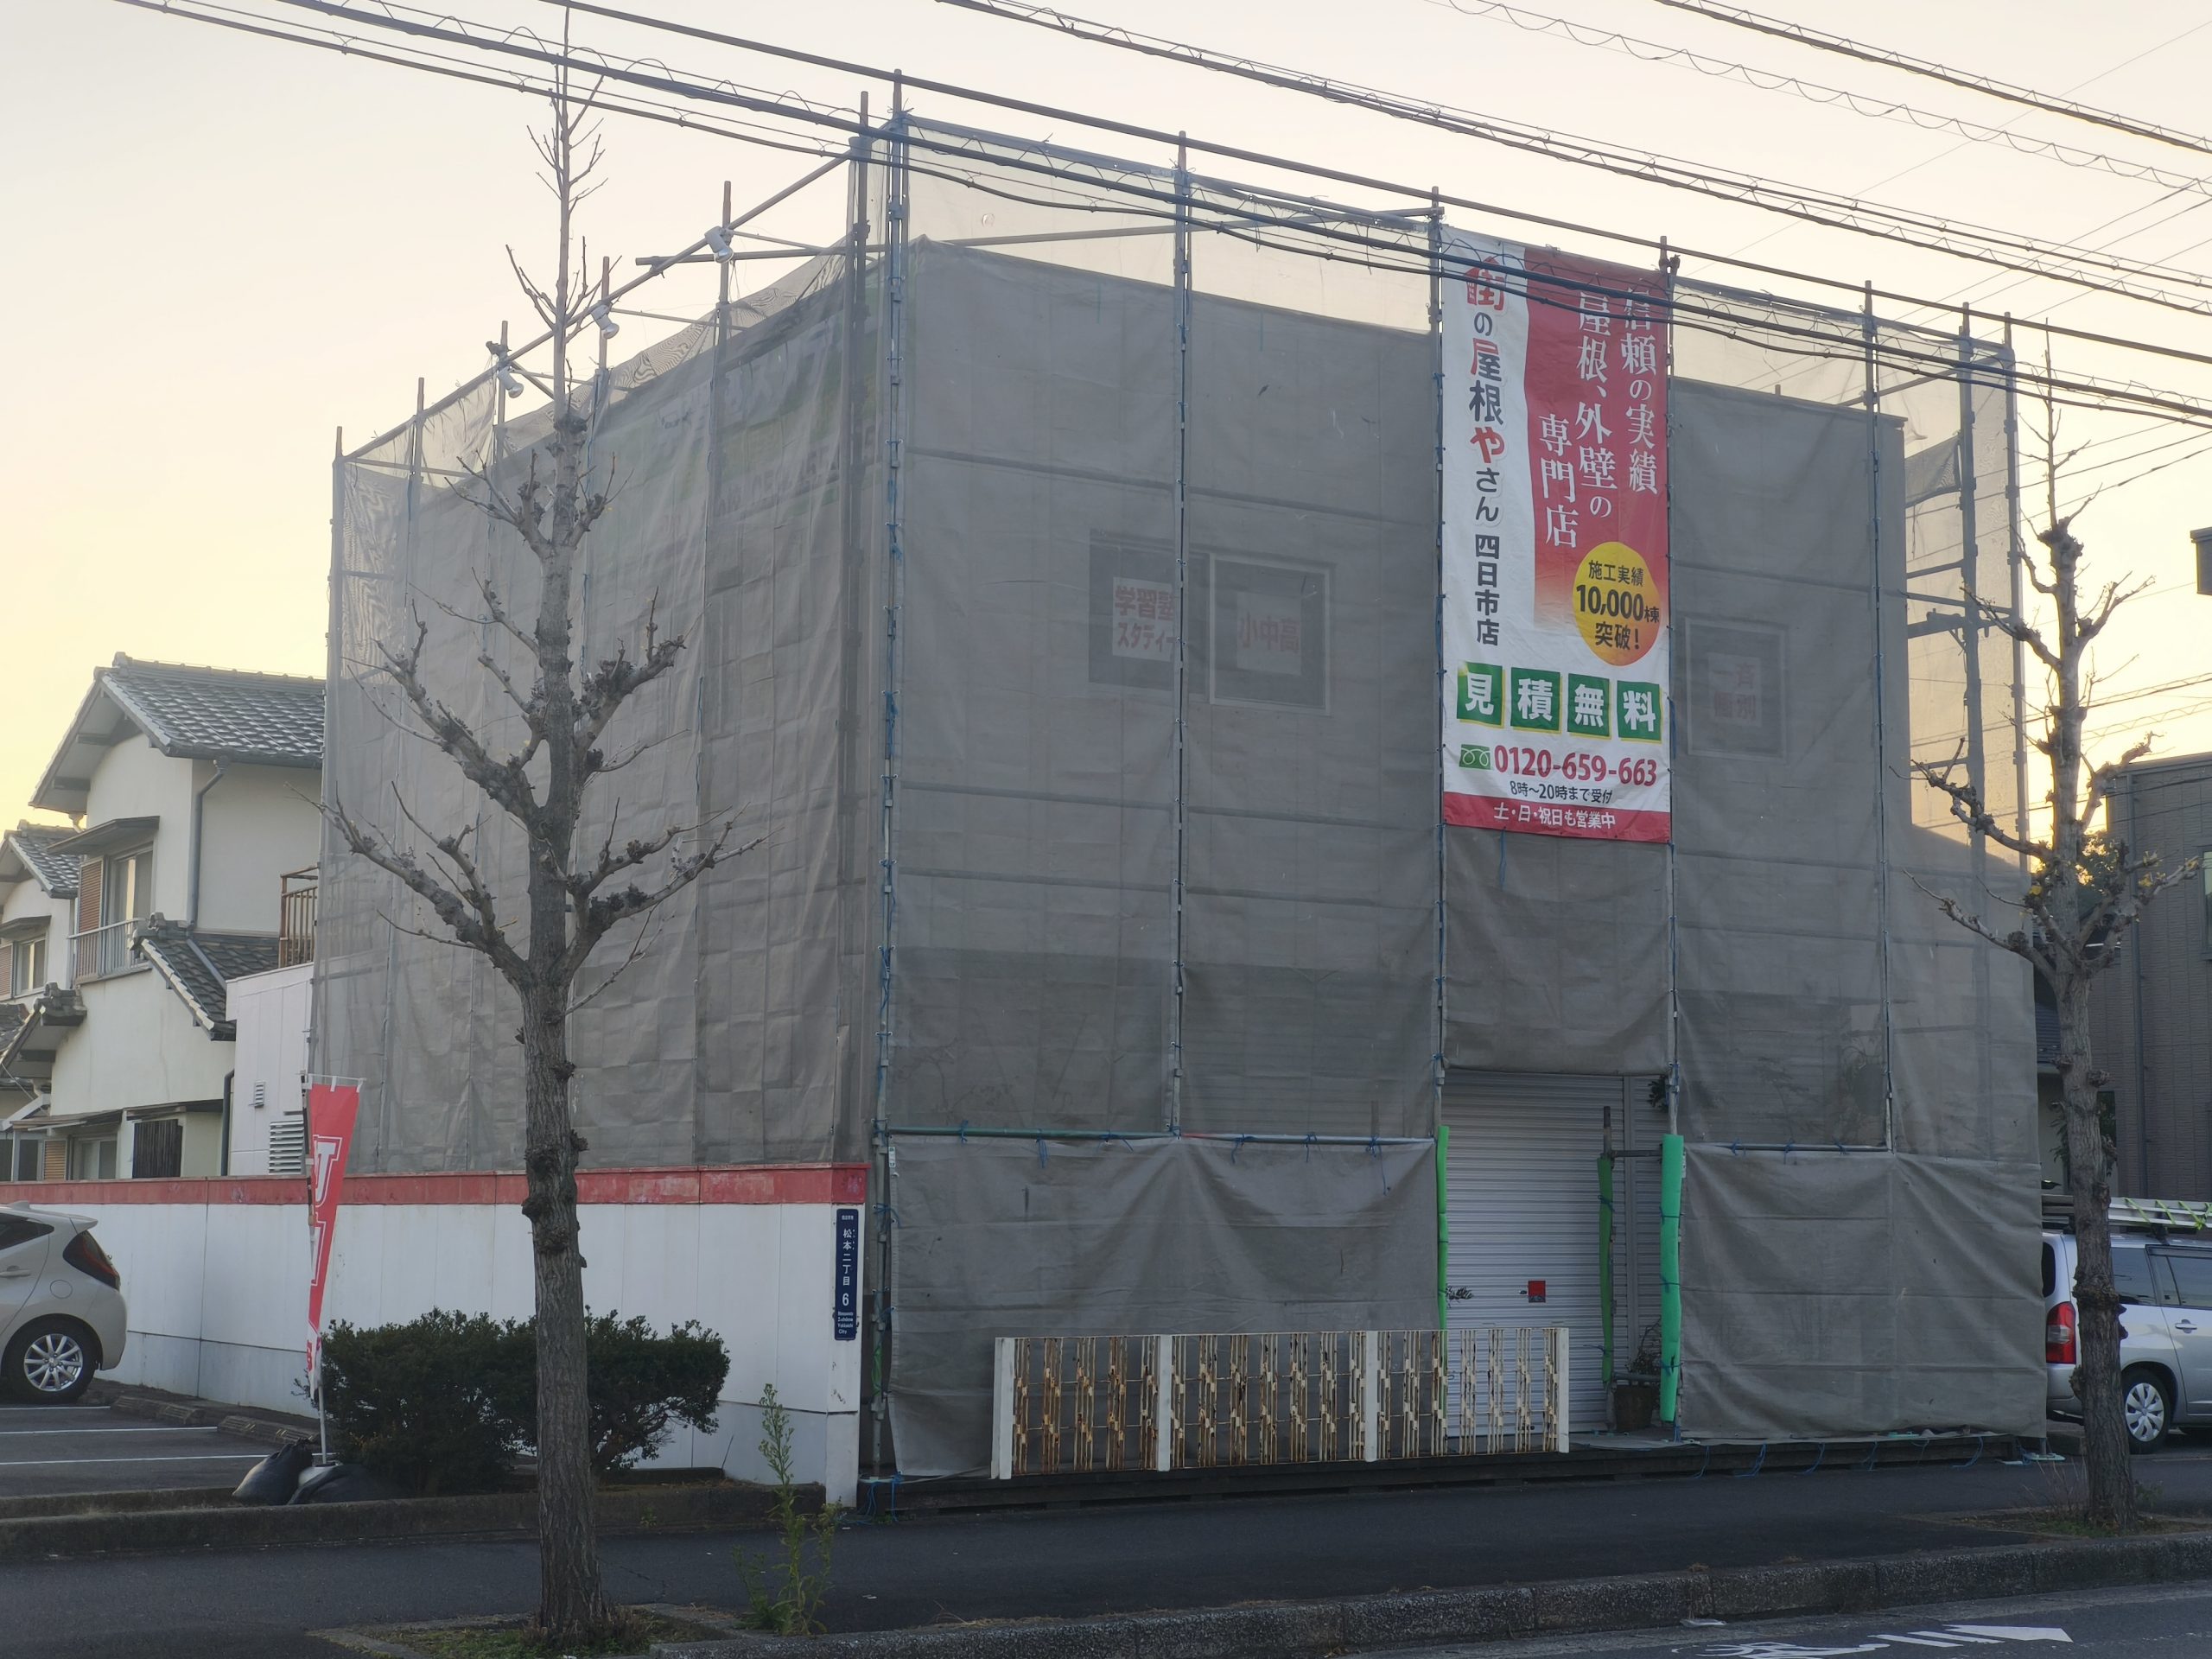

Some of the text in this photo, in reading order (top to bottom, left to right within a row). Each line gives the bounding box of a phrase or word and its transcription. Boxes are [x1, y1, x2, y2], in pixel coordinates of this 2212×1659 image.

[1575, 292, 1618, 518] 屋根、外壁の
[1619, 288, 1658, 495] 信頼の実績
[1538, 414, 1580, 549] 専門店
[1474, 534, 1500, 646] 四日市店
[1588, 560, 1644, 588] 施工実績
[1465, 672, 1656, 733] 見積無料
[1494, 745, 1657, 787] 0120-659-663
[842, 1228, 852, 1287] 松本二丁目
[842, 1293, 849, 1306] 6
